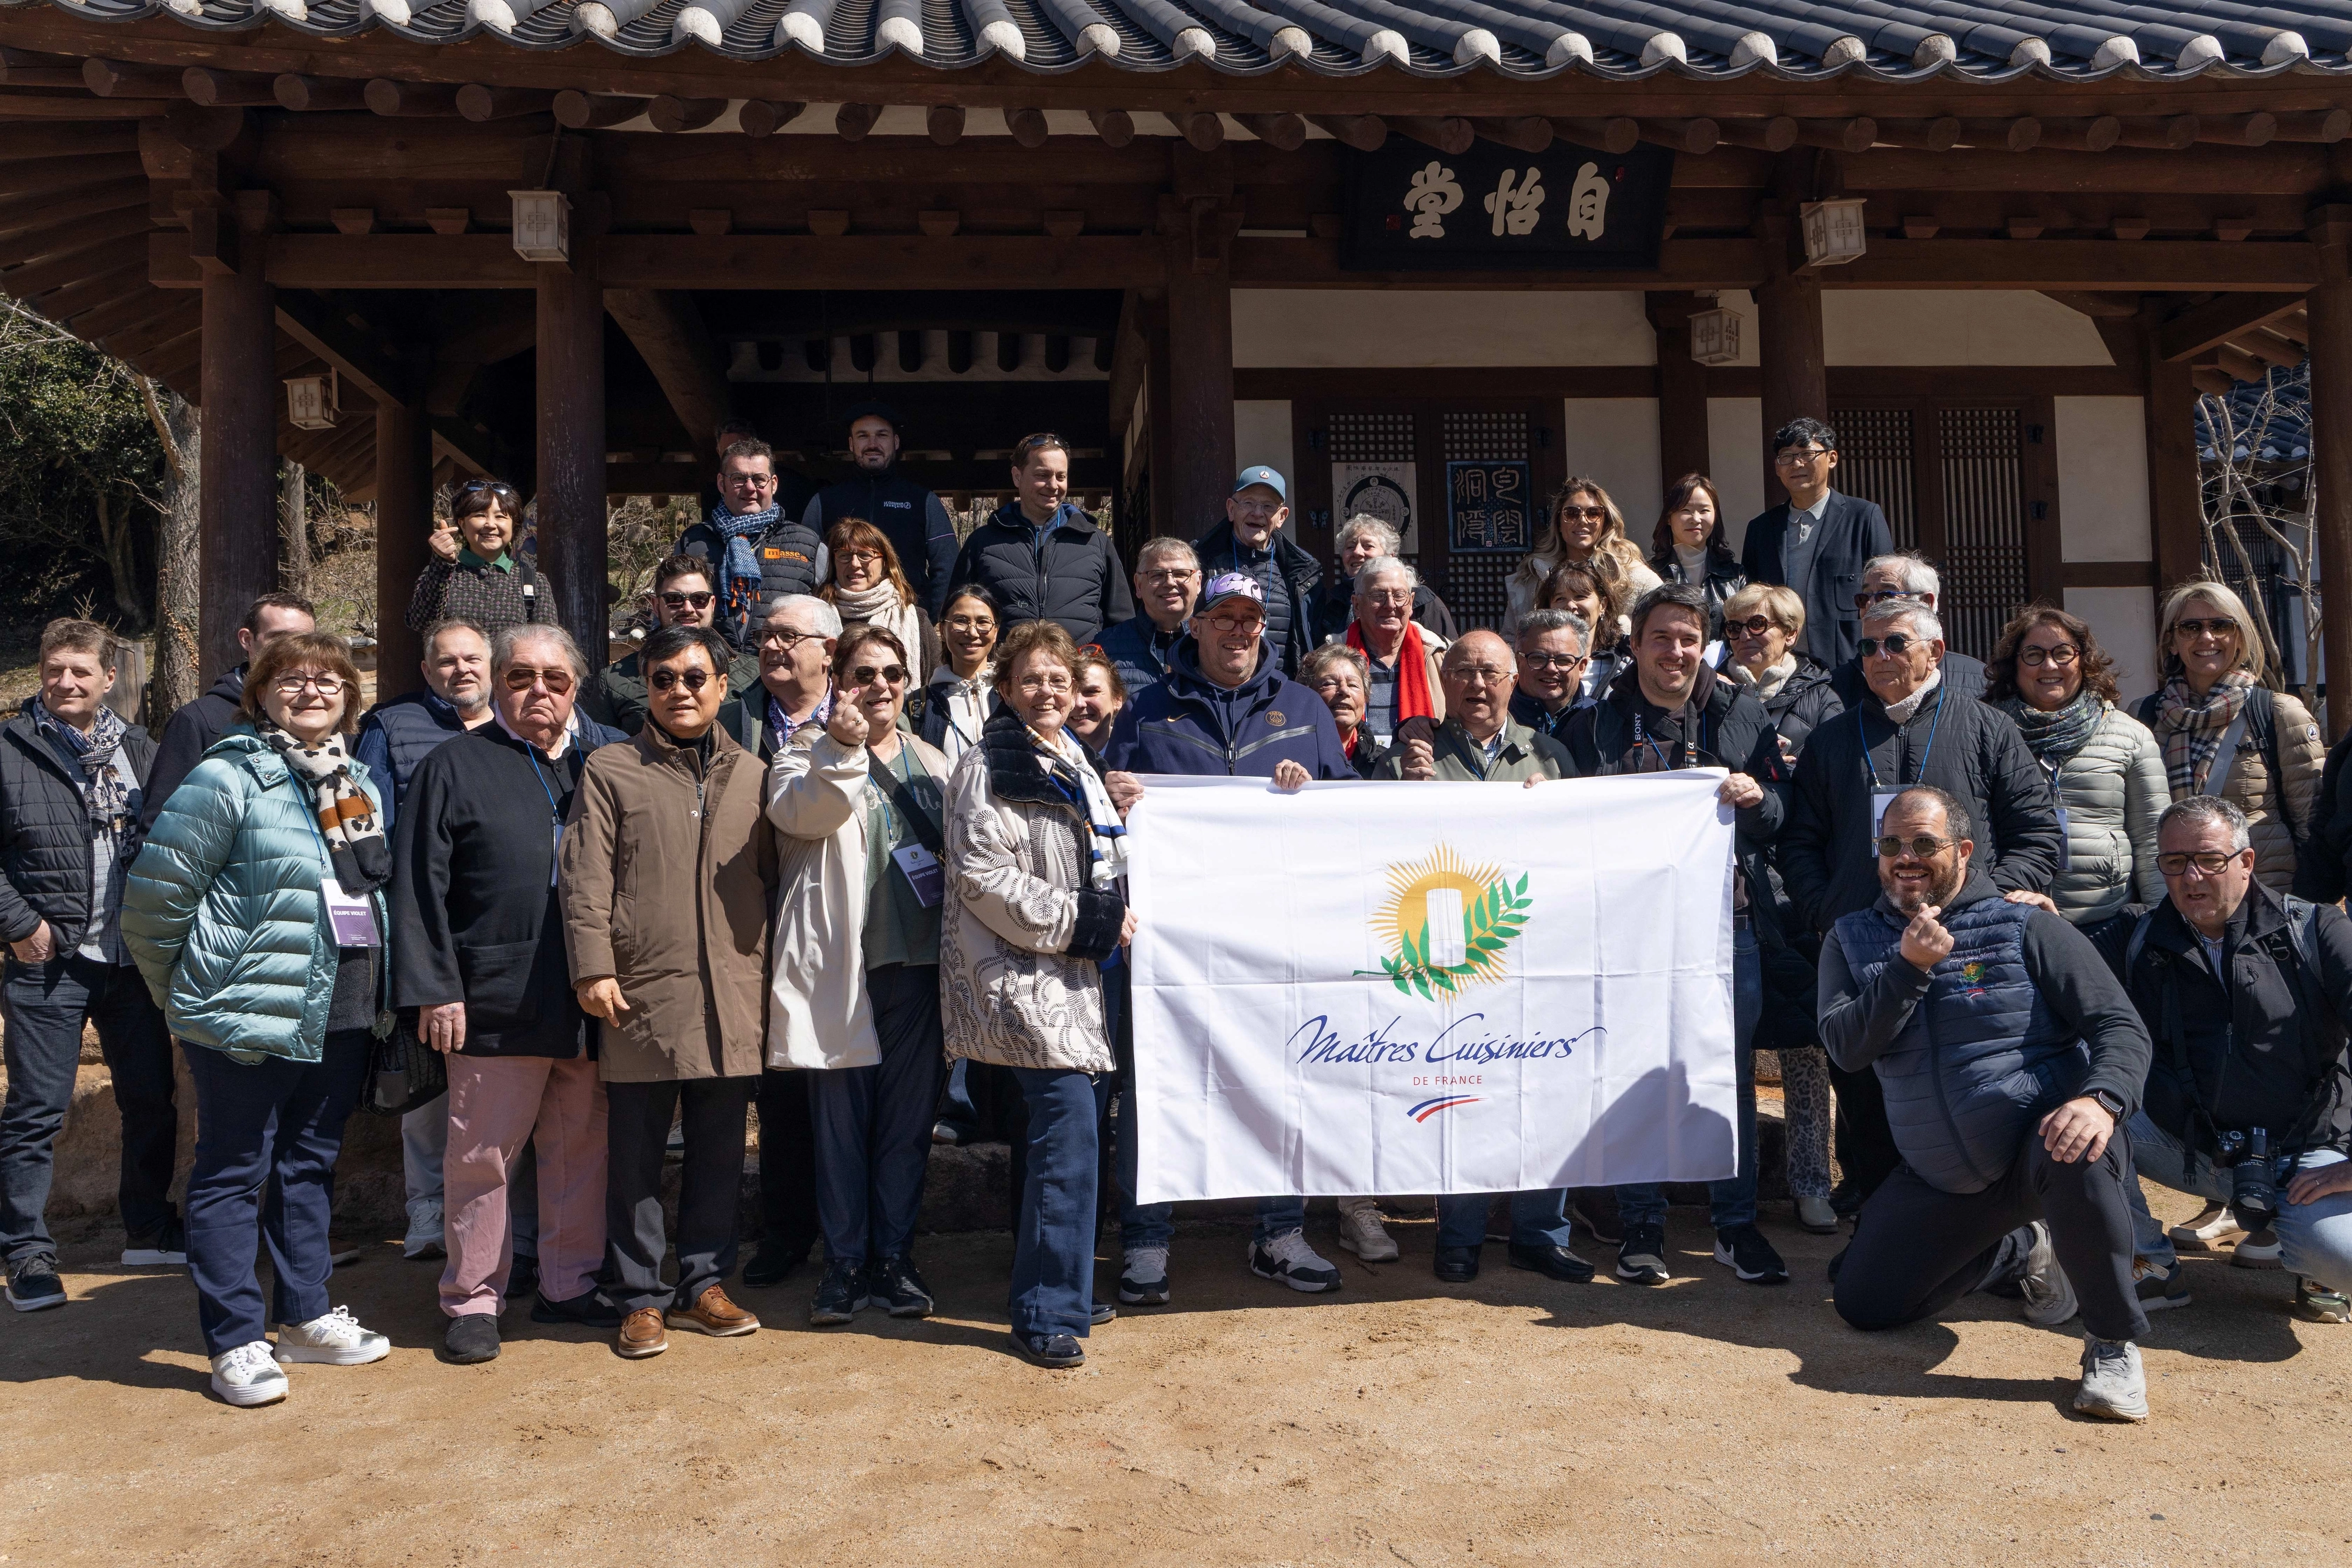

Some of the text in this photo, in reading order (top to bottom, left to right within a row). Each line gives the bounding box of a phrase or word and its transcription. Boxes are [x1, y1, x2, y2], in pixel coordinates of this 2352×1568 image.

[1966, 951, 1996, 961] Saint-Martin
[1287, 1013, 1608, 1065] Maîtres Cuisiniers
[1413, 1075, 1482, 1086] DE FRANCE
